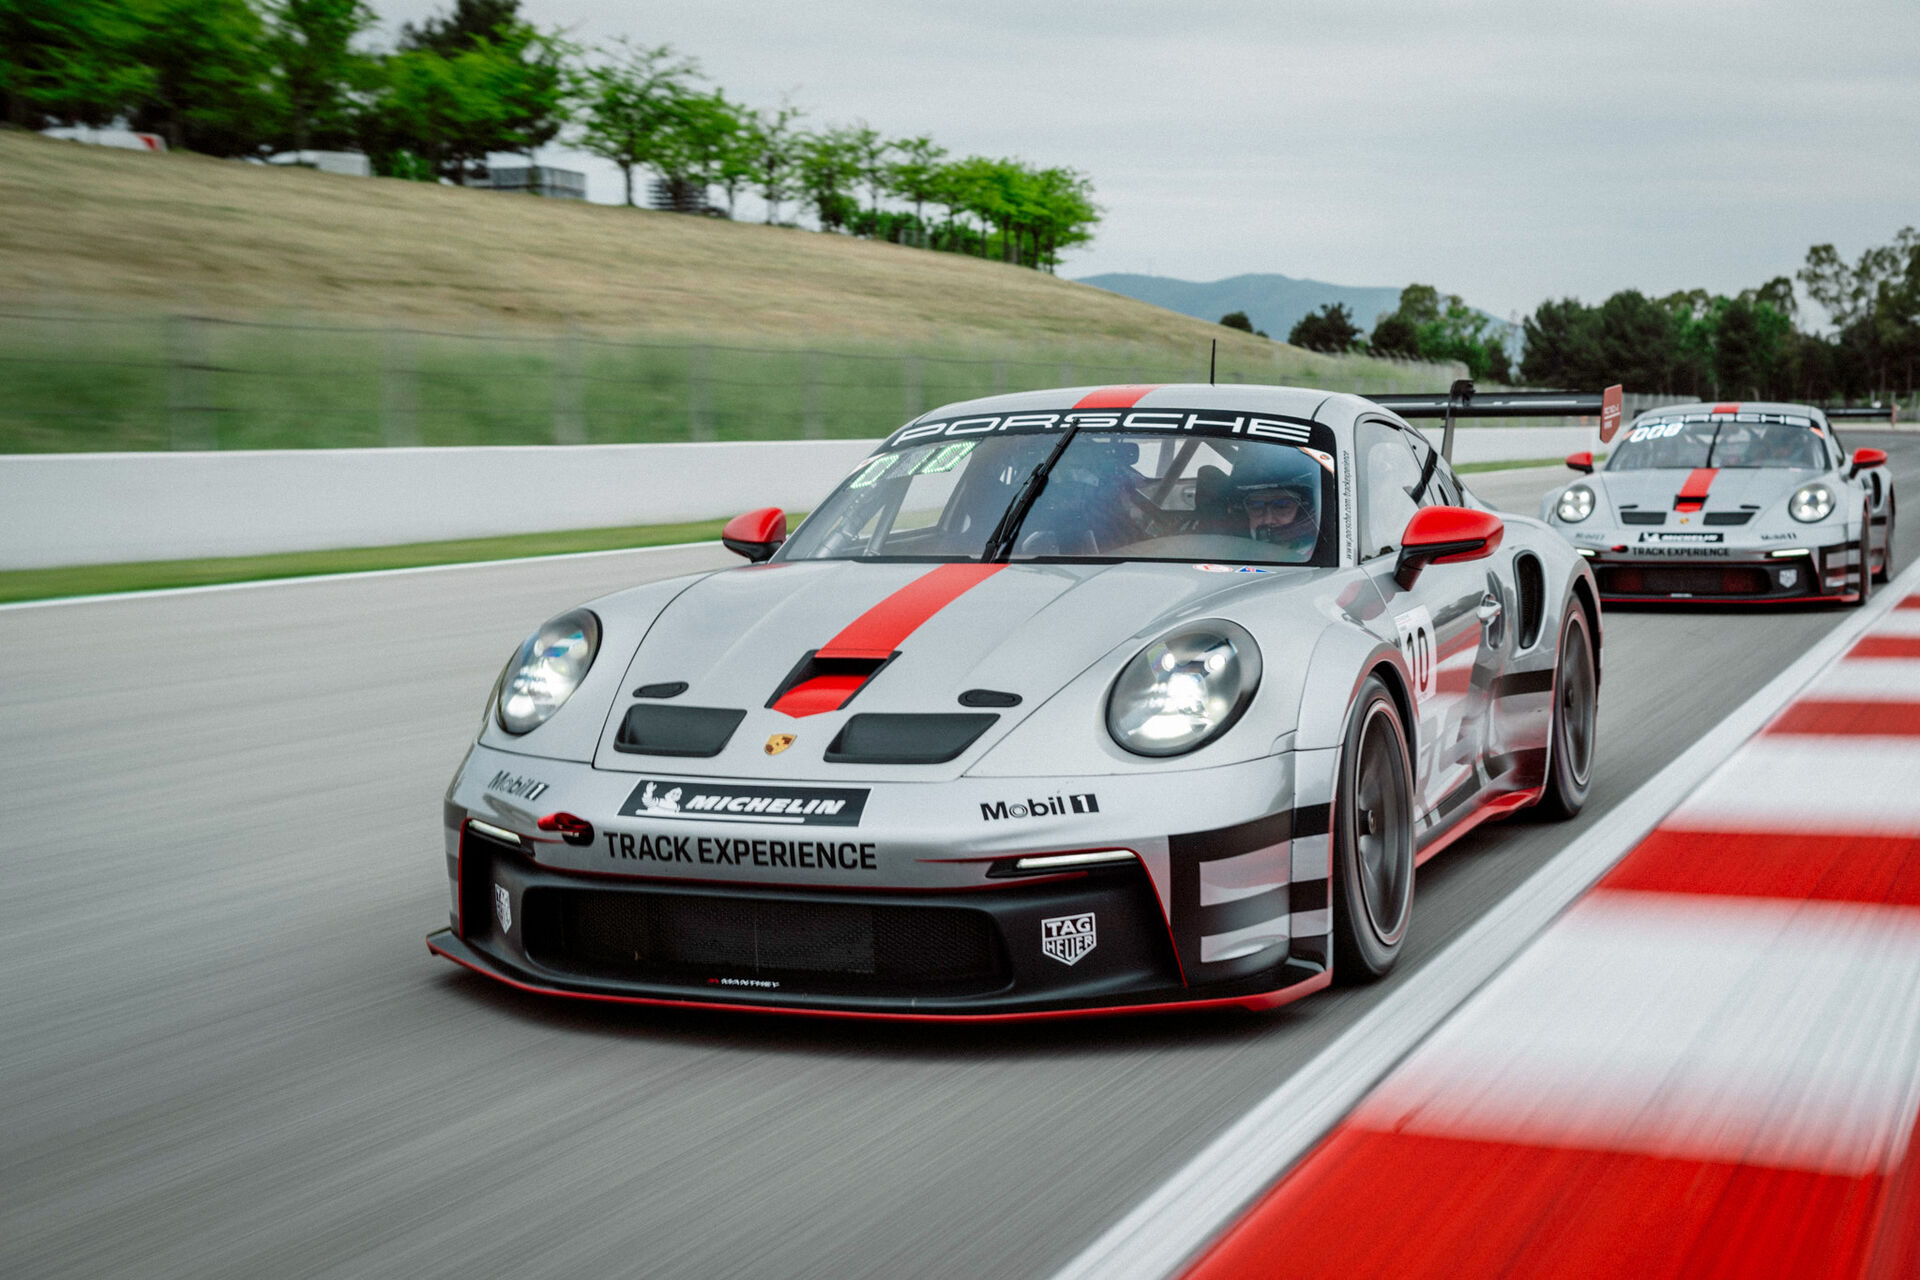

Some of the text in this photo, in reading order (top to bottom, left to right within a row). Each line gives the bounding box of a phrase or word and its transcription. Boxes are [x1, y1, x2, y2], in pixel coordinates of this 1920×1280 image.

[892, 412, 1311, 447] PORSCHE
[1632, 547, 1730, 557] TRACK EXPERIENCE
[1406, 627, 1429, 693] 10
[685, 795, 846, 815] MICHELIN
[980, 794, 1095, 821] Mobil 1
[603, 831, 877, 870] TRACK EXPERIENCE
[1046, 917, 1091, 937] TAG
[1046, 935, 1093, 960] HEUER
